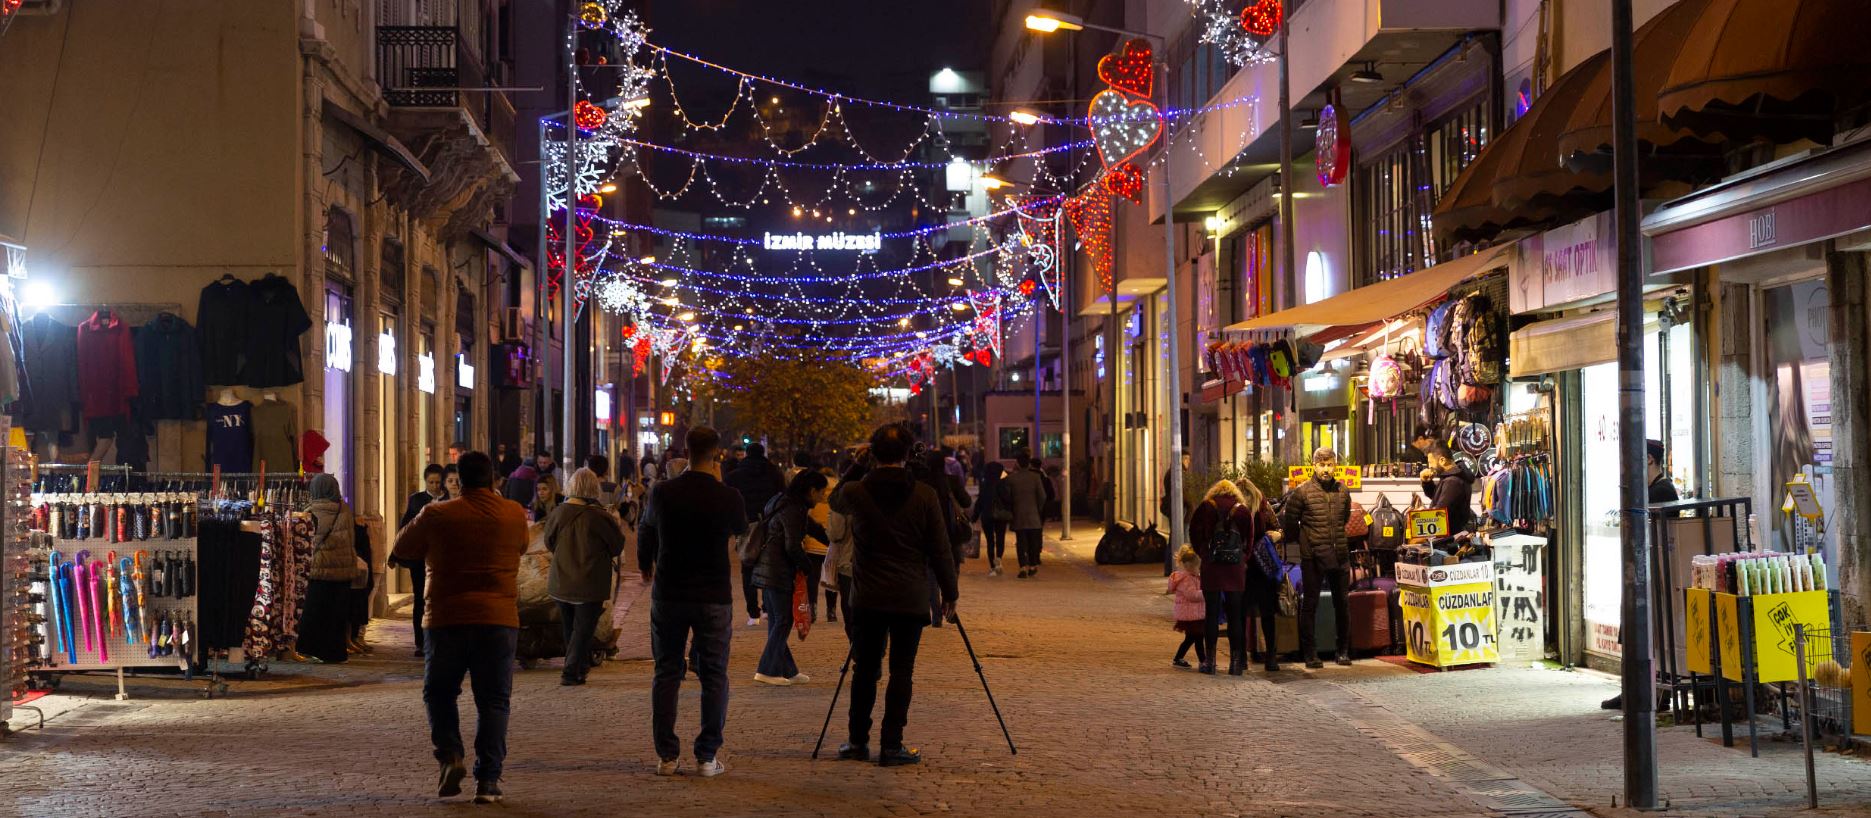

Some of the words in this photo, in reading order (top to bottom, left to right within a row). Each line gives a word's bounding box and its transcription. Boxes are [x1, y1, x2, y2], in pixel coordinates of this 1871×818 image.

[1750, 207, 1776, 249] HOBİ
[764, 231, 814, 250] İZMİR
[817, 231, 881, 250] MÜZESİ
[1574, 233, 1598, 277] OPTİK
[1417, 523, 1438, 536] 10
[1449, 568, 1480, 582] CÜZDANLAR
[1442, 623, 1480, 651] 10
[1482, 634, 1496, 645] TL
